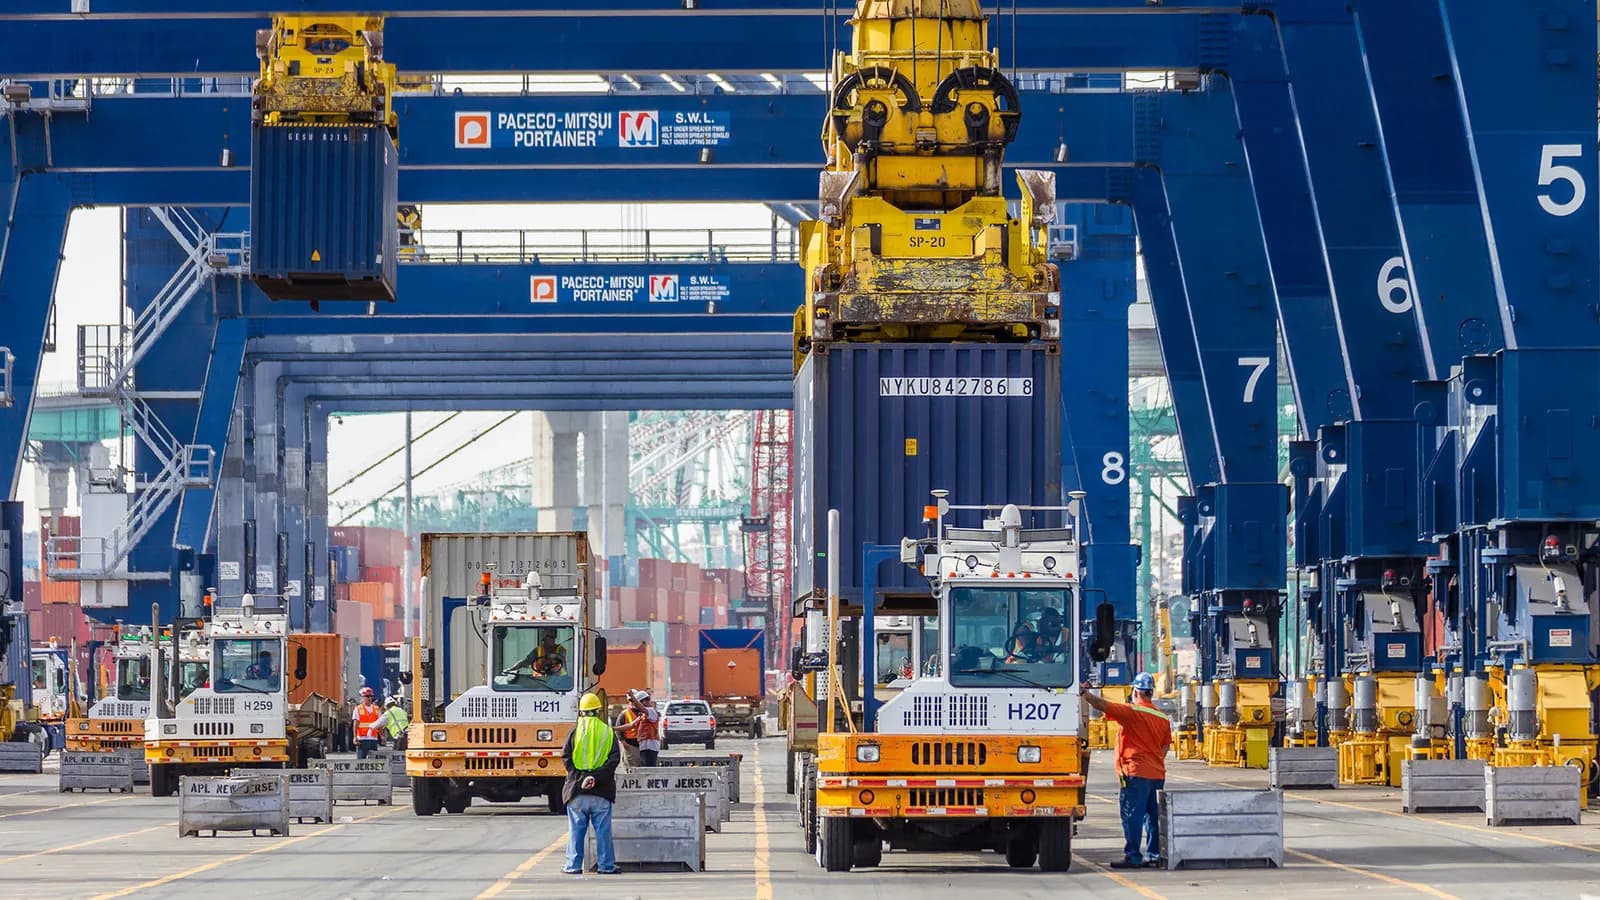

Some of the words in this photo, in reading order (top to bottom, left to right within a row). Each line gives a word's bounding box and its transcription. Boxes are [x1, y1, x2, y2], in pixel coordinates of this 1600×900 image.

[498, 112, 612, 129] PACECO-MITSUI
[514, 130, 596, 147] PORTAINER
[1537, 144, 1586, 217] 5
[909, 236, 946, 248] SP-20
[561, 276, 644, 289] PACECO-MITSUI
[1377, 257, 1413, 314] 6
[881, 379, 1007, 395] NYKU842786
[1023, 379, 1032, 395] 8
[1237, 357, 1270, 403] 7
[1101, 451, 1126, 486] 8
[244, 701, 273, 711] H259
[534, 700, 560, 712] H211
[1008, 703, 1062, 720] H207
[354, 763, 385, 771] JERSEY
[290, 774, 320, 783] ERSEY
[621, 779, 642, 789] APL
[647, 779, 669, 788] NEW
[675, 778, 713, 788] JERSEY
[190, 783, 210, 793] APL
